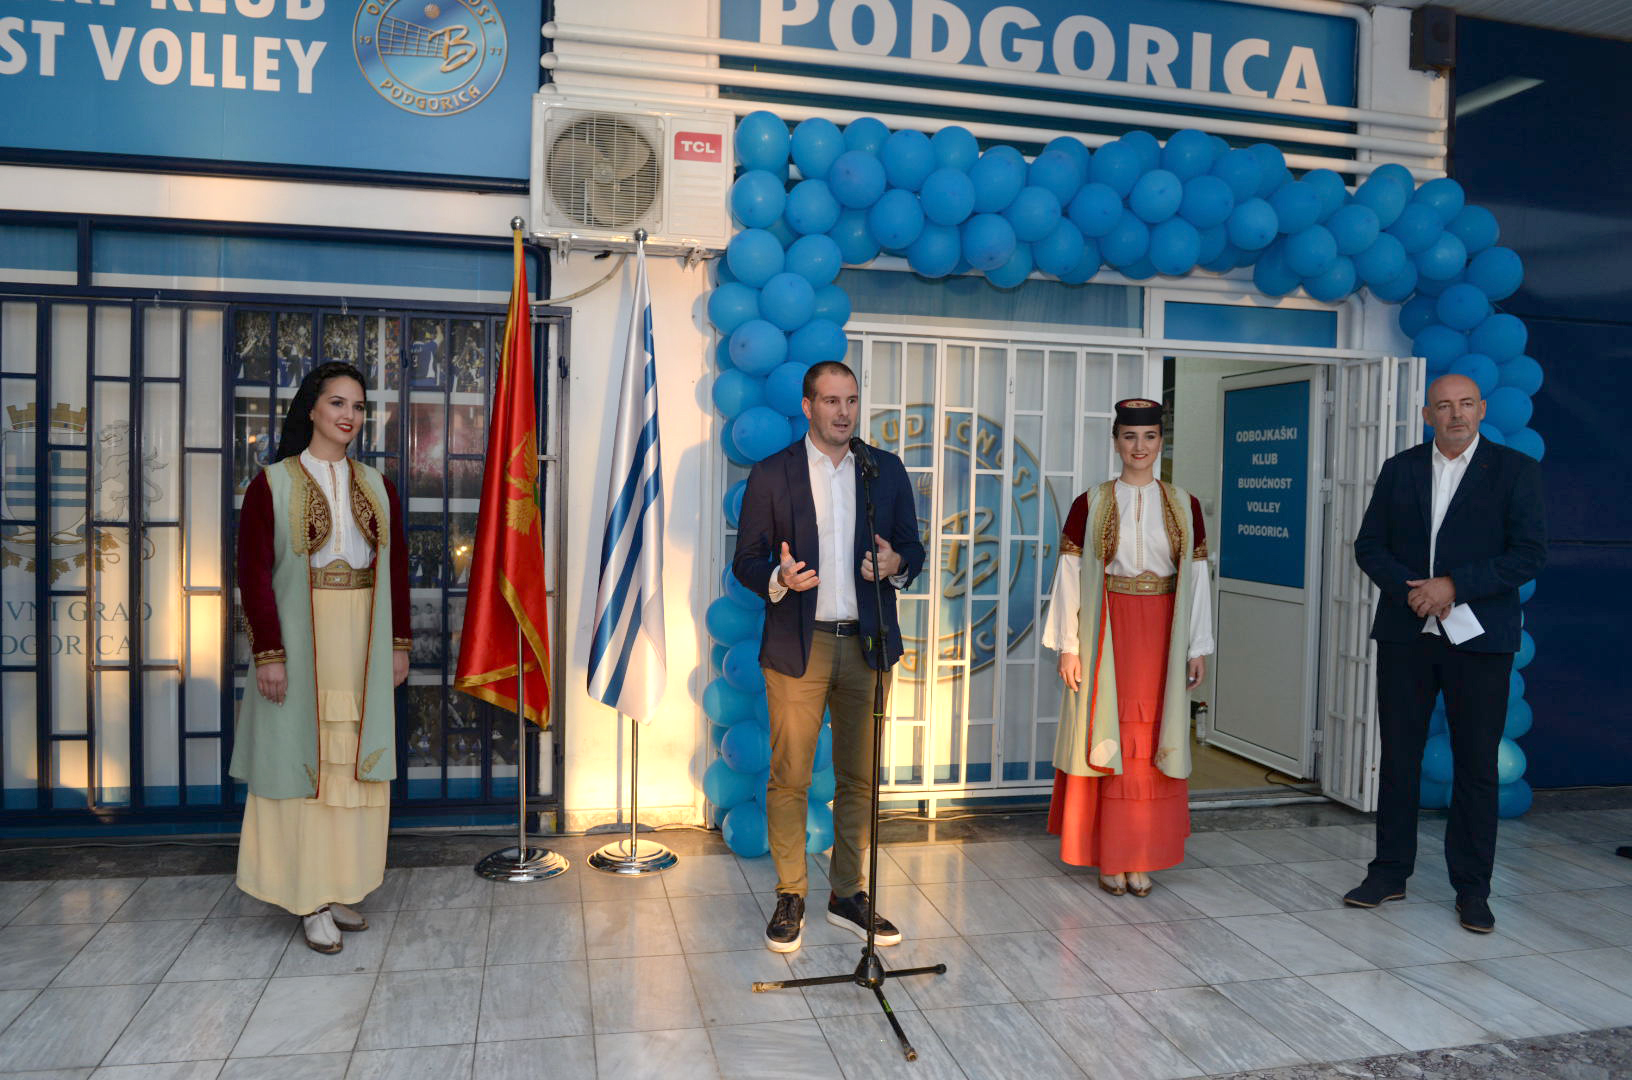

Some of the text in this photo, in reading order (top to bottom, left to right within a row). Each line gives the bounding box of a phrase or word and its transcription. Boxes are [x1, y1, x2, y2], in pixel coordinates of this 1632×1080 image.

[0, 16, 327, 94] ST VOLLEY
[759, 0, 1328, 105] PODGORICA
[380, 78, 482, 111] PODGORICA
[680, 140, 716, 154] TCL
[1236, 426, 1298, 442] ODBOJKAŠKI
[1252, 453, 1279, 465] KLUB
[1247, 501, 1281, 513] VOLLEY
[1238, 524, 1289, 538] PODGORICA
[0, 634, 130, 656] DGORCA
